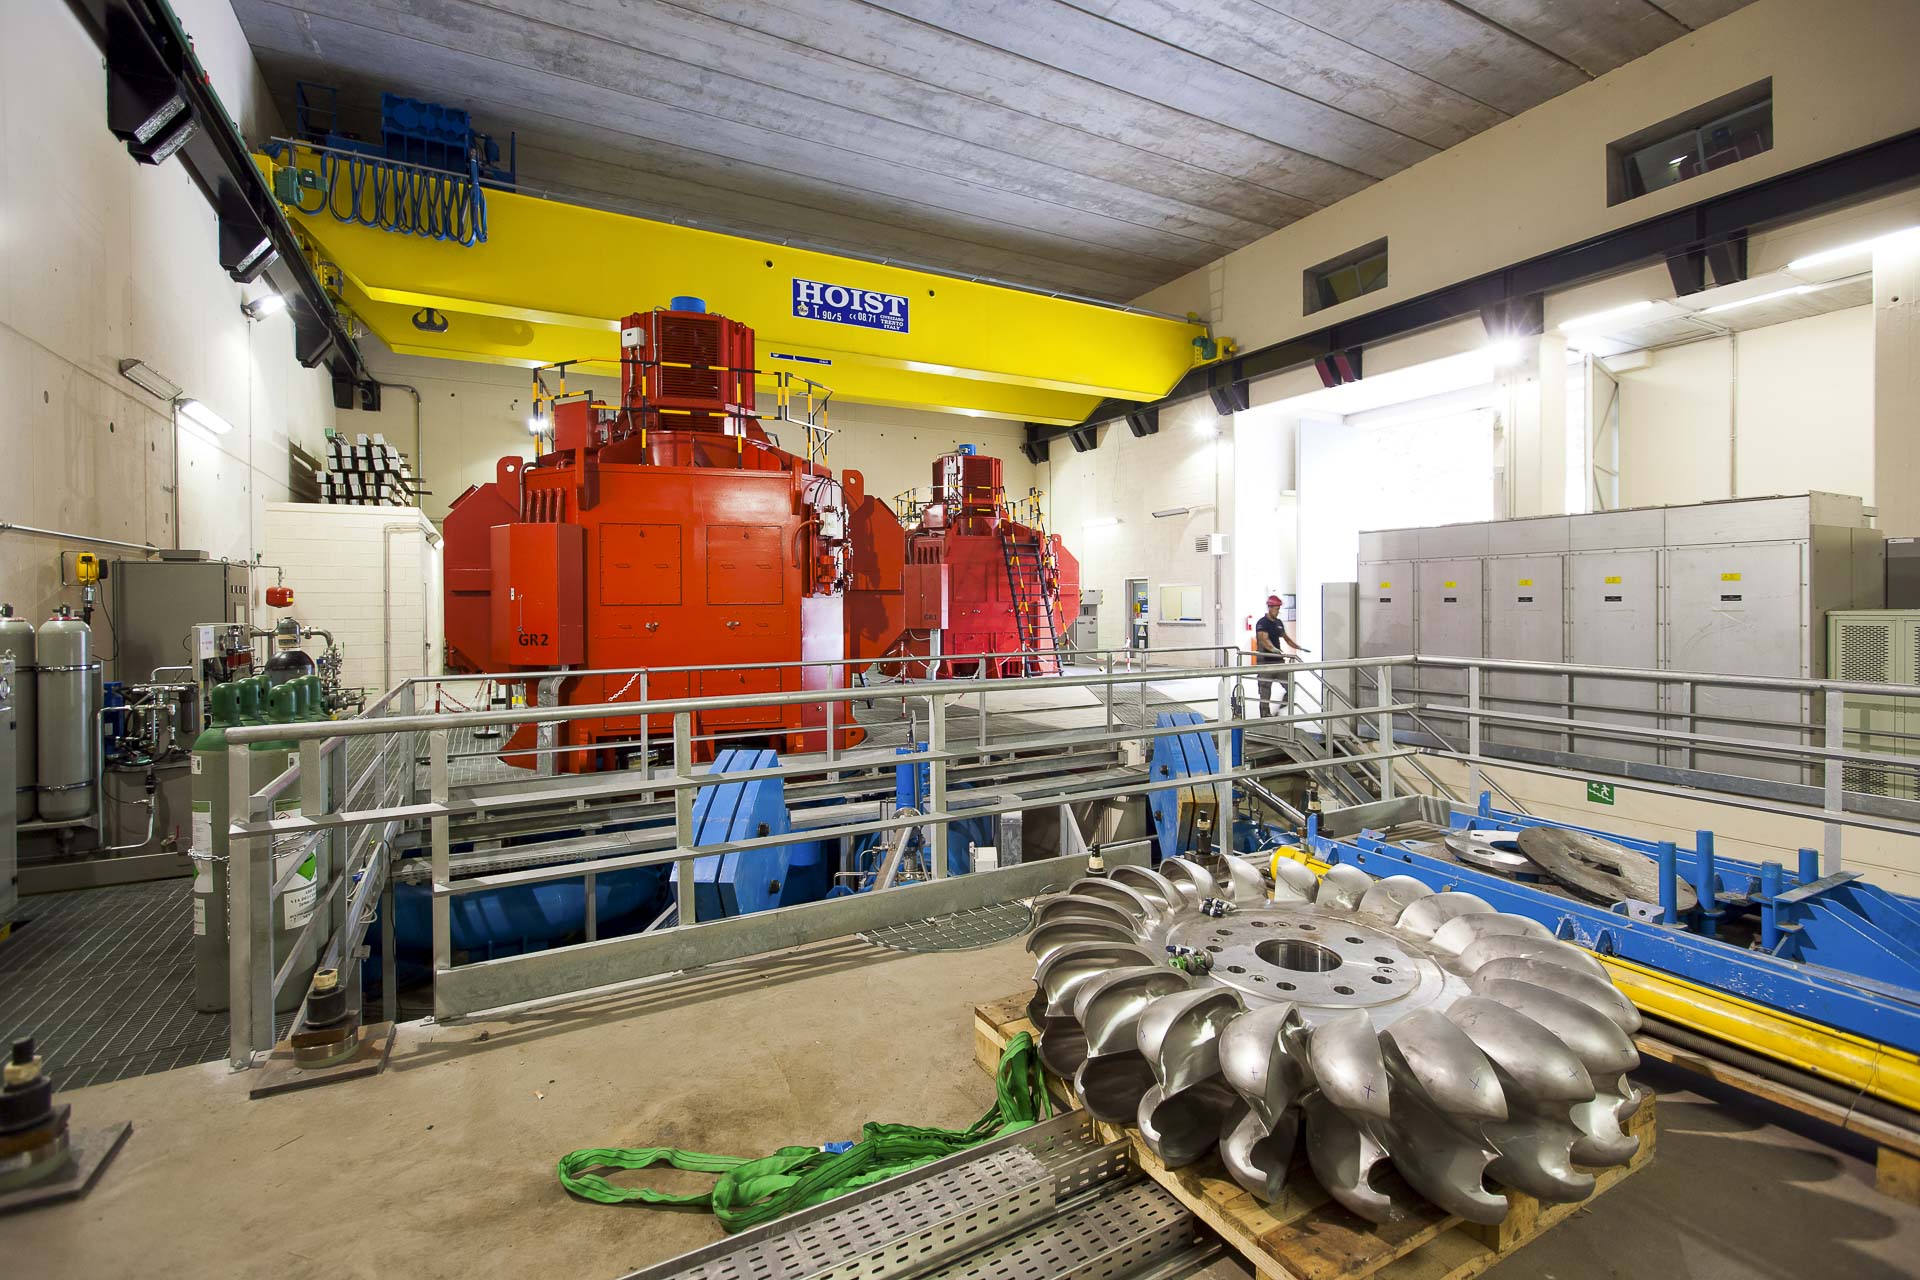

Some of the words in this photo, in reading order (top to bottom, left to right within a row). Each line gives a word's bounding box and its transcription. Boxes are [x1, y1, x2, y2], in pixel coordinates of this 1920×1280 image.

[797, 280, 906, 317] HOIST
[813, 305, 820, 318] T.
[822, 310, 842, 322] 90/5
[880, 319, 904, 327] TRENTO
